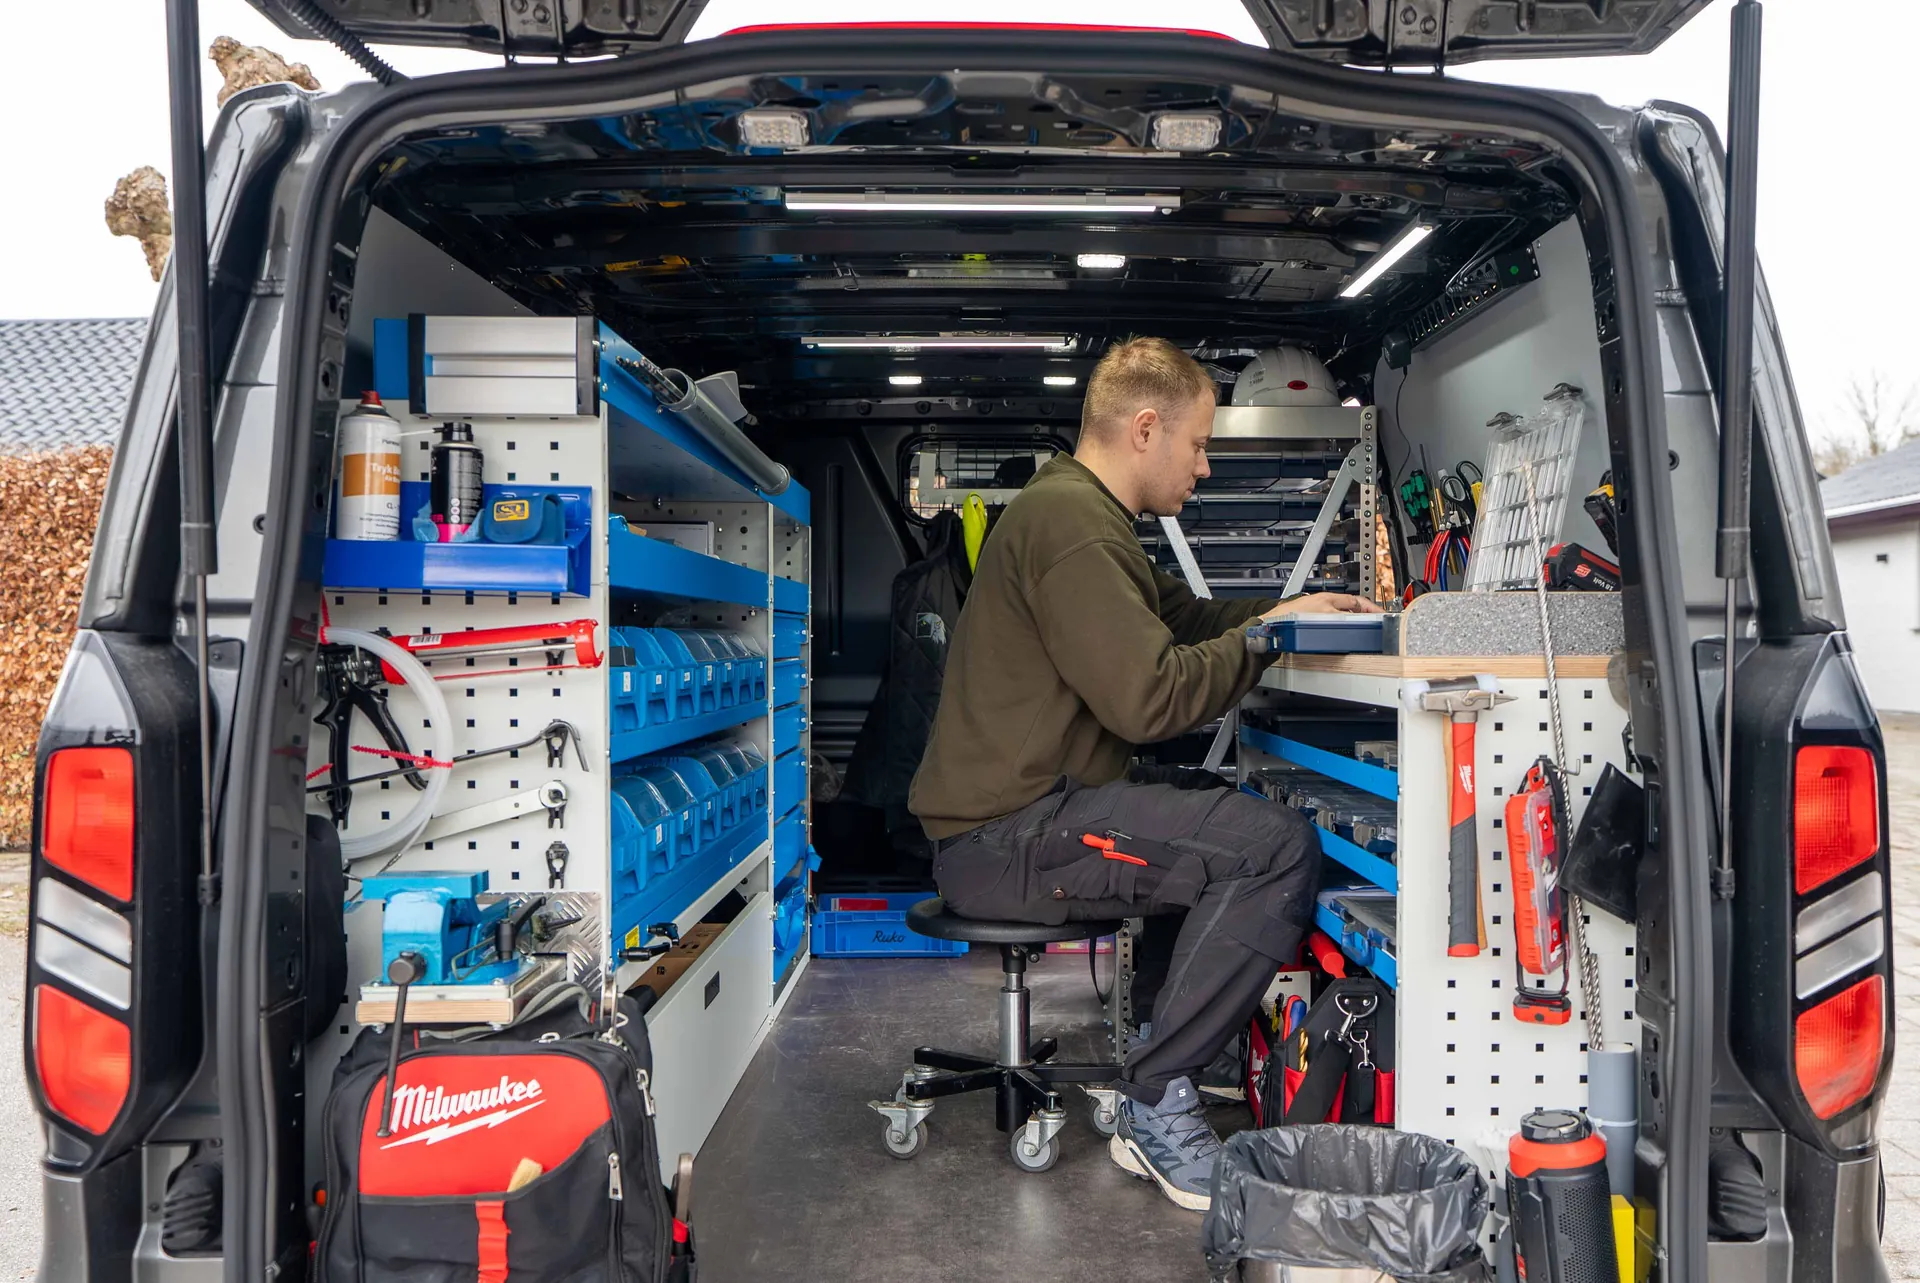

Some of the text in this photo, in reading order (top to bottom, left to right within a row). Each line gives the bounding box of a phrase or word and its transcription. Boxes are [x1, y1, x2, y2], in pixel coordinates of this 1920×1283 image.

[1593, 577, 1605, 588] Volt
[872, 930, 906, 943] Ruko
[390, 1075, 543, 1134] Milwaukee
